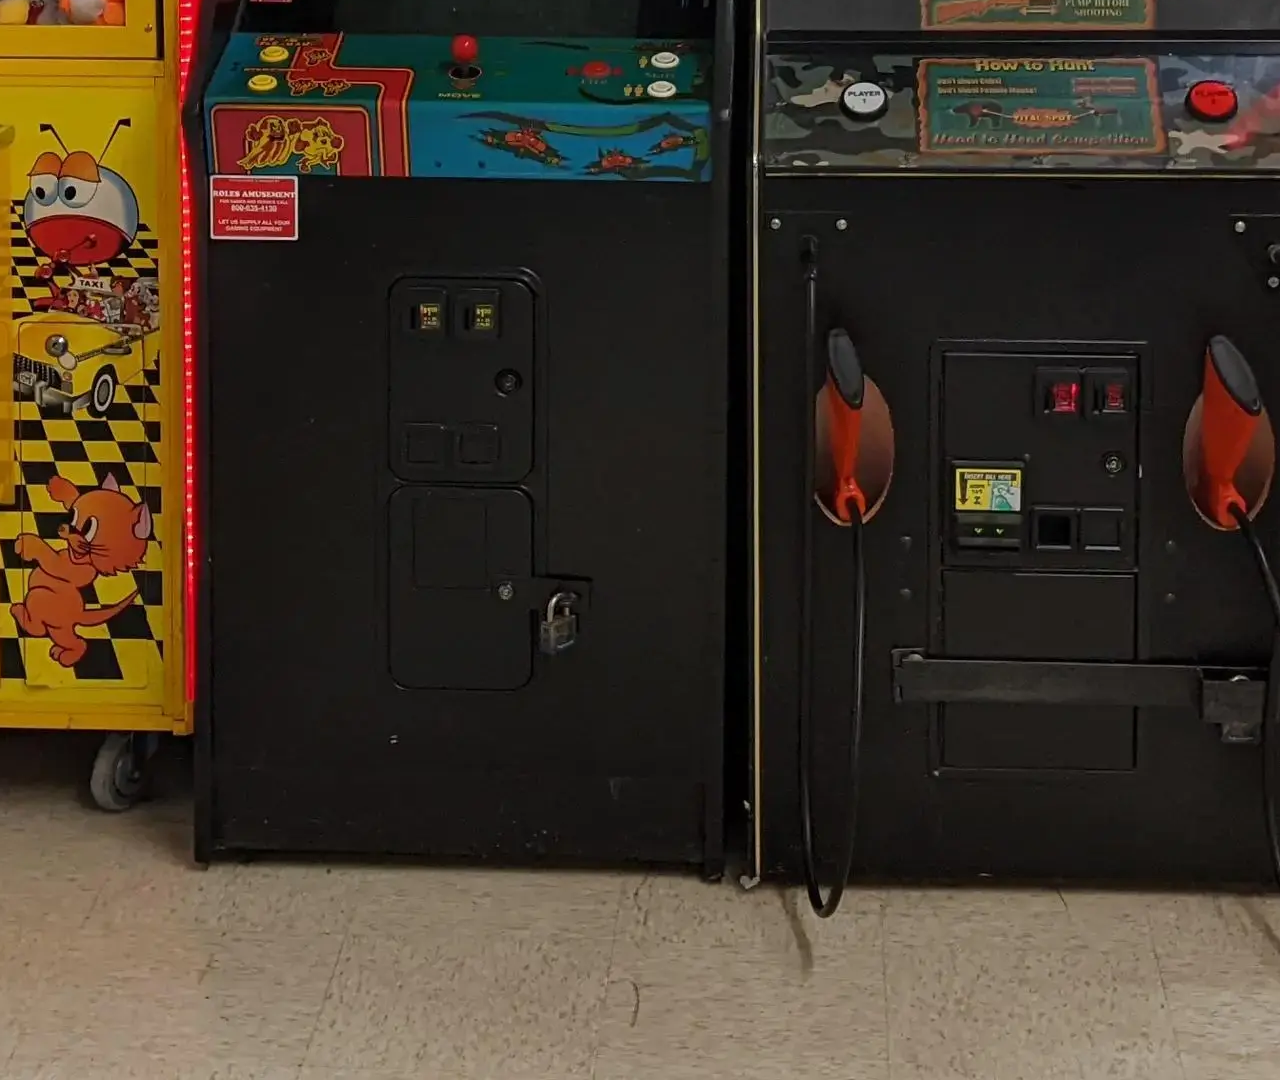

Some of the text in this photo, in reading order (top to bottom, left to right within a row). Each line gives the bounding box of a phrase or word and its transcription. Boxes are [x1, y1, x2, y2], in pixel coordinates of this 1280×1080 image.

[1065, 0, 1130, 7] PUMP BEFORE
[1073, 8, 1122, 17] SHOOTING
[975, 59, 1095, 71] How to Hunt
[933, 133, 1149, 146] Head to Head Competition
[242, 190, 297, 198] AMUSEMENT
[80, 280, 103, 289] TAXI
